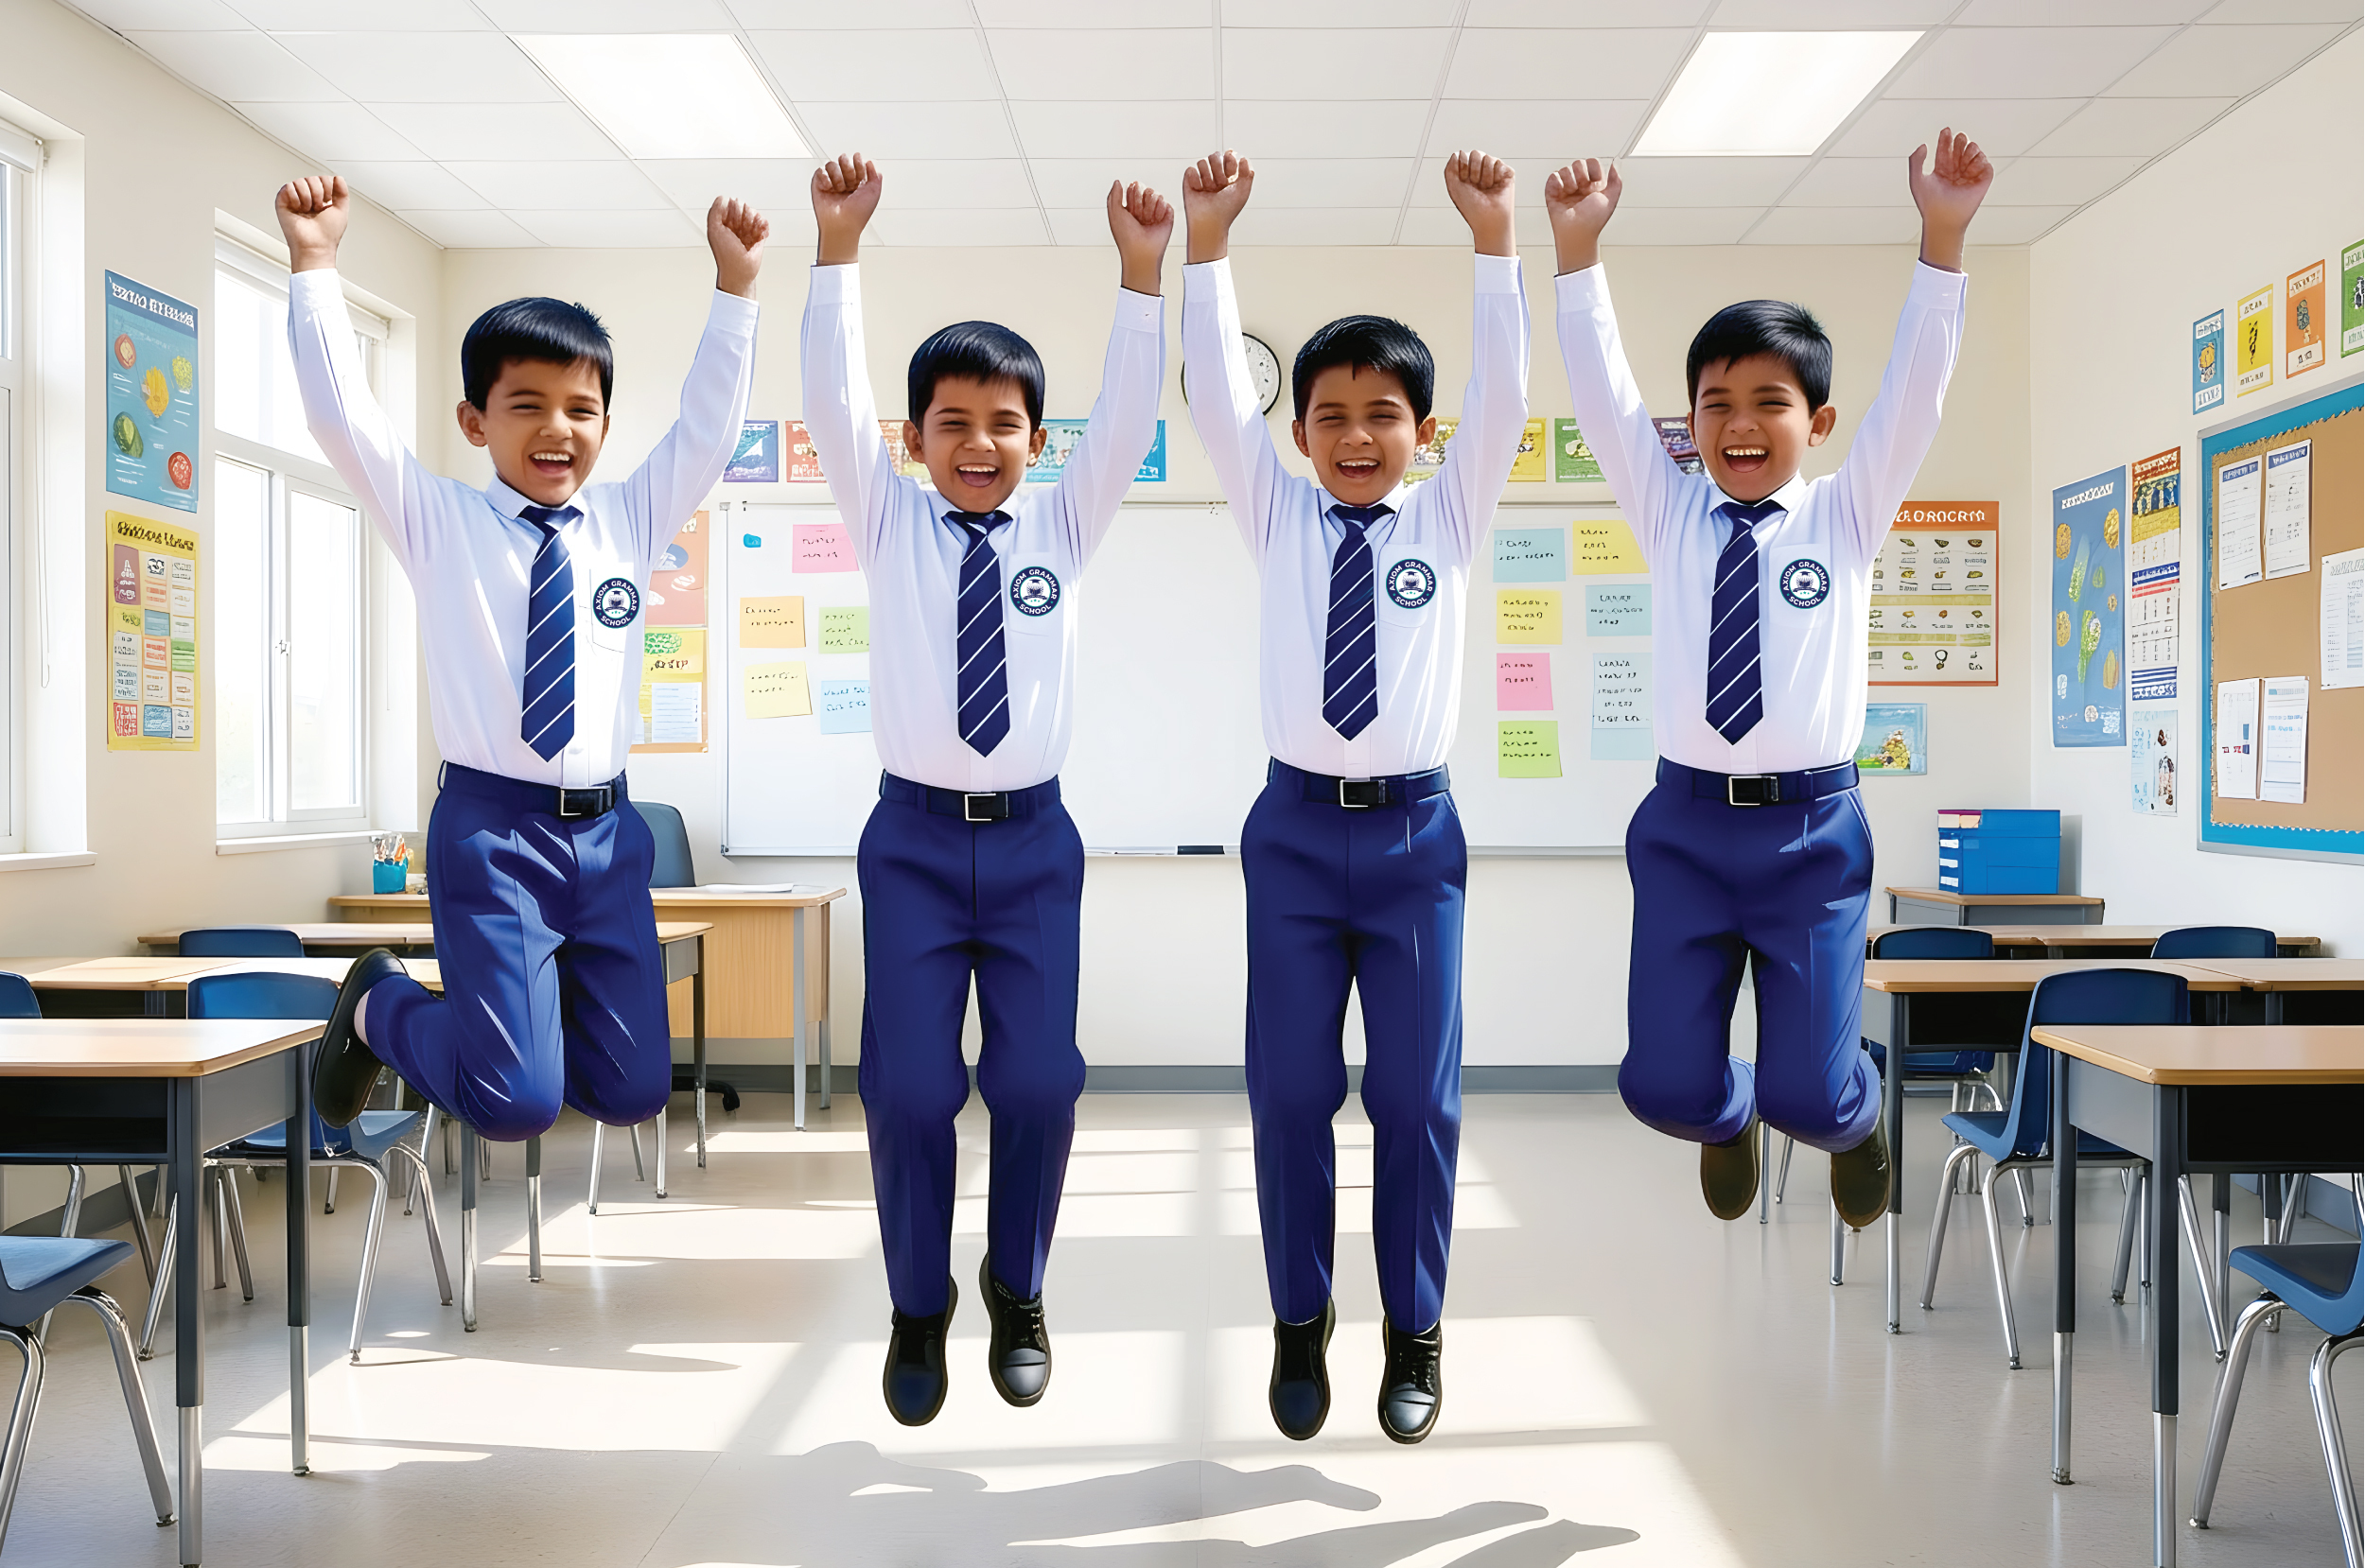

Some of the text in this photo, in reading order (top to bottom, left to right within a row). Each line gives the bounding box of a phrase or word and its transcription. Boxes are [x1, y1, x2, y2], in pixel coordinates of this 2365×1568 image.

[1013, 568, 1058, 600] AXIOM GRAMMAR
[1388, 561, 1433, 592] AXIOM GRAMMAR
[1782, 561, 1828, 592] AXIOM GRAMMAR
[595, 580, 637, 611] AXIOM GRAMMAR
[1394, 596, 1428, 606] SCHOOL
[1788, 596, 1822, 606] SCHOOL
[1019, 603, 1052, 615] SCHOOL
[601, 616, 631, 626] SCHOOL
